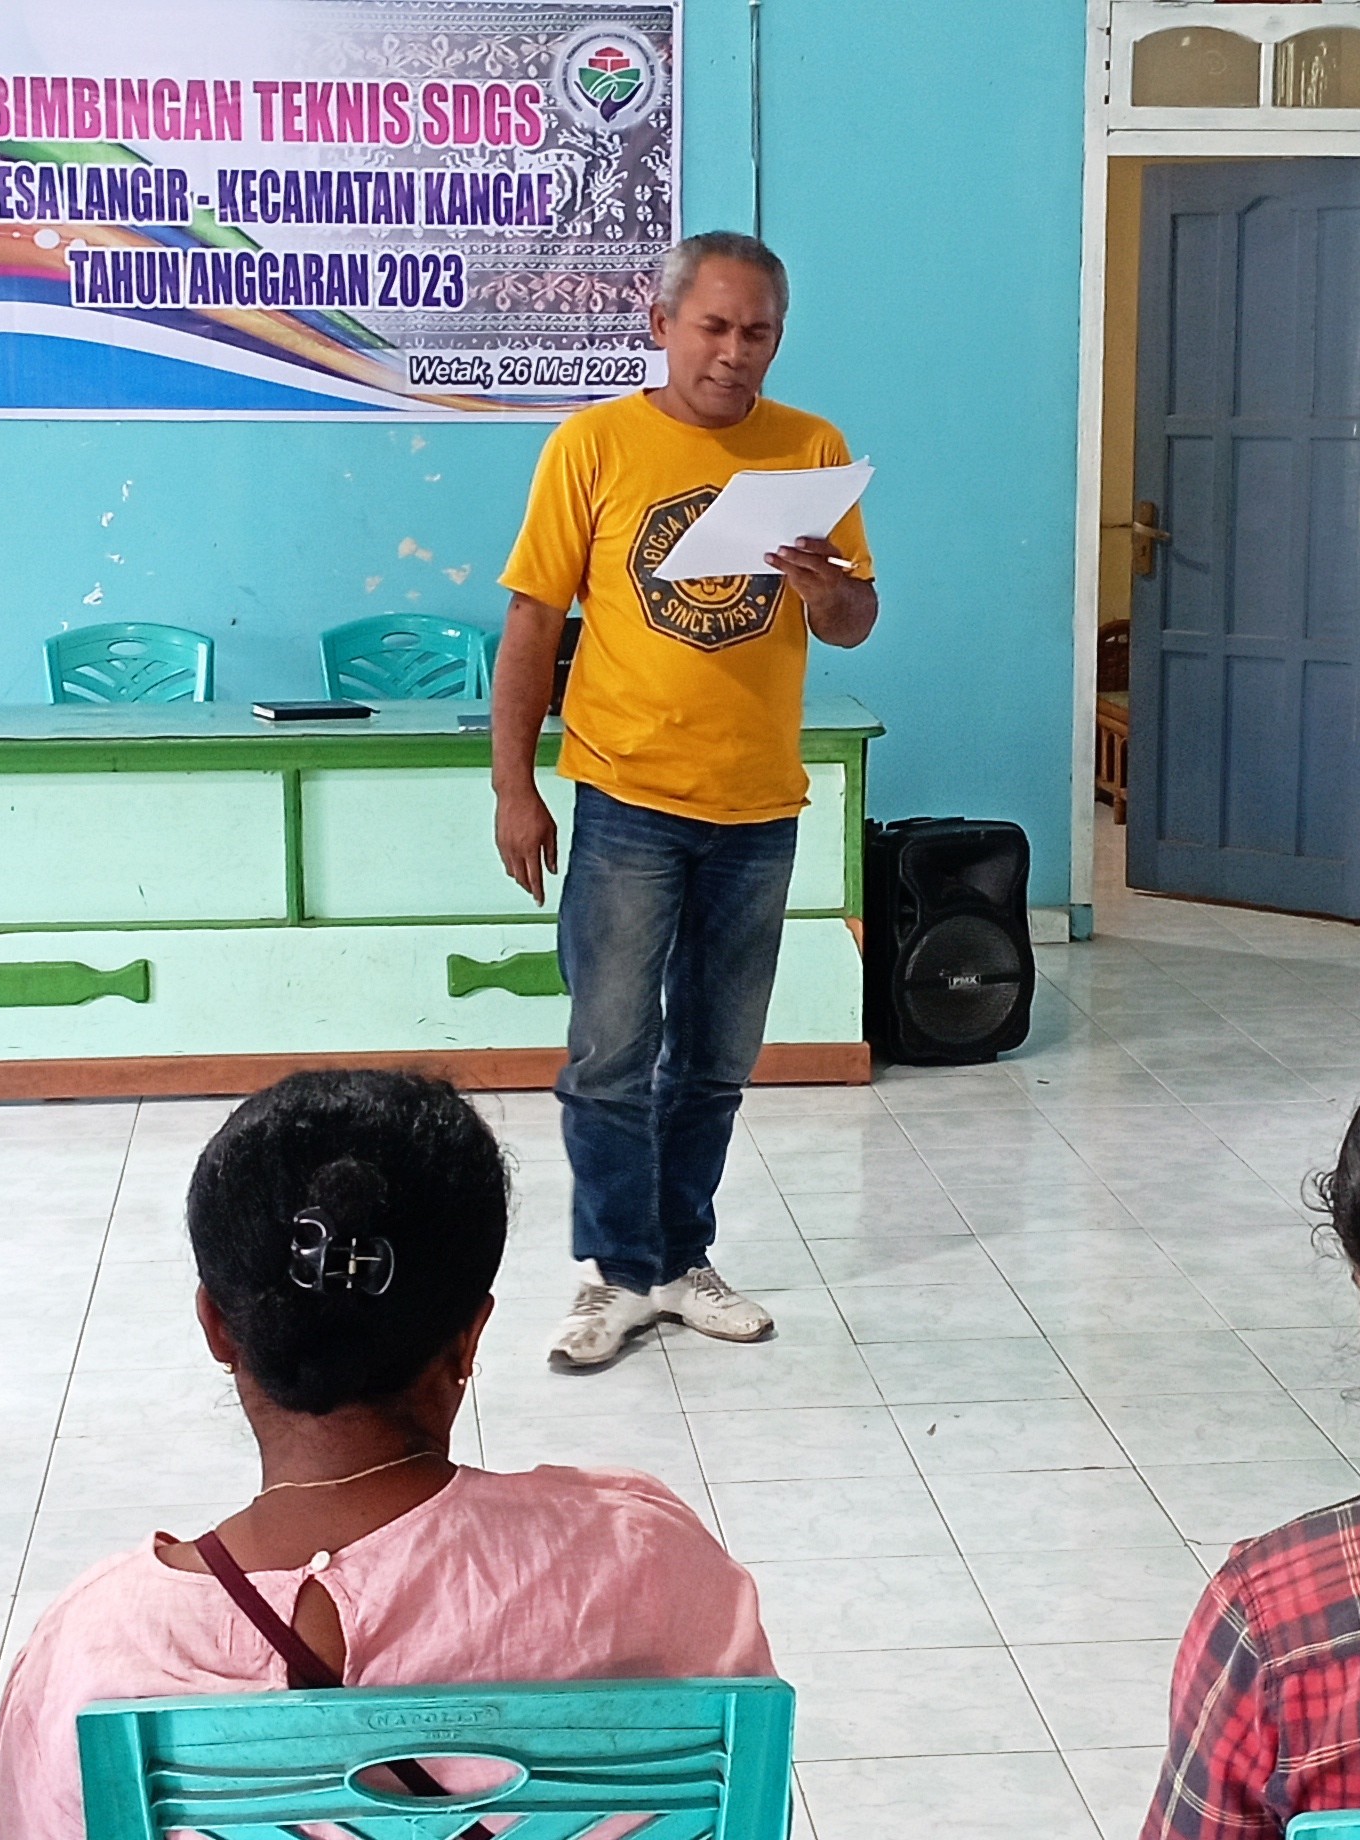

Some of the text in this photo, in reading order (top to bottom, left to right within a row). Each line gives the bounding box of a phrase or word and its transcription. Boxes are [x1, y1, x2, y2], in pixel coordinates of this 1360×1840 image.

[253, 80, 410, 144] TEKNIS
[422, 82, 542, 146] SDGS
[67, 166, 189, 221] LANGIR
[218, 169, 415, 225] KECAMATAN
[424, 172, 553, 226] KANGAE
[69, 251, 464, 308] TAHUN ANGGARAN 2023
[409, 356, 647, 389] Wetak, 26 Mei 2023
[661, 598, 758, 634] SINCE 1755
